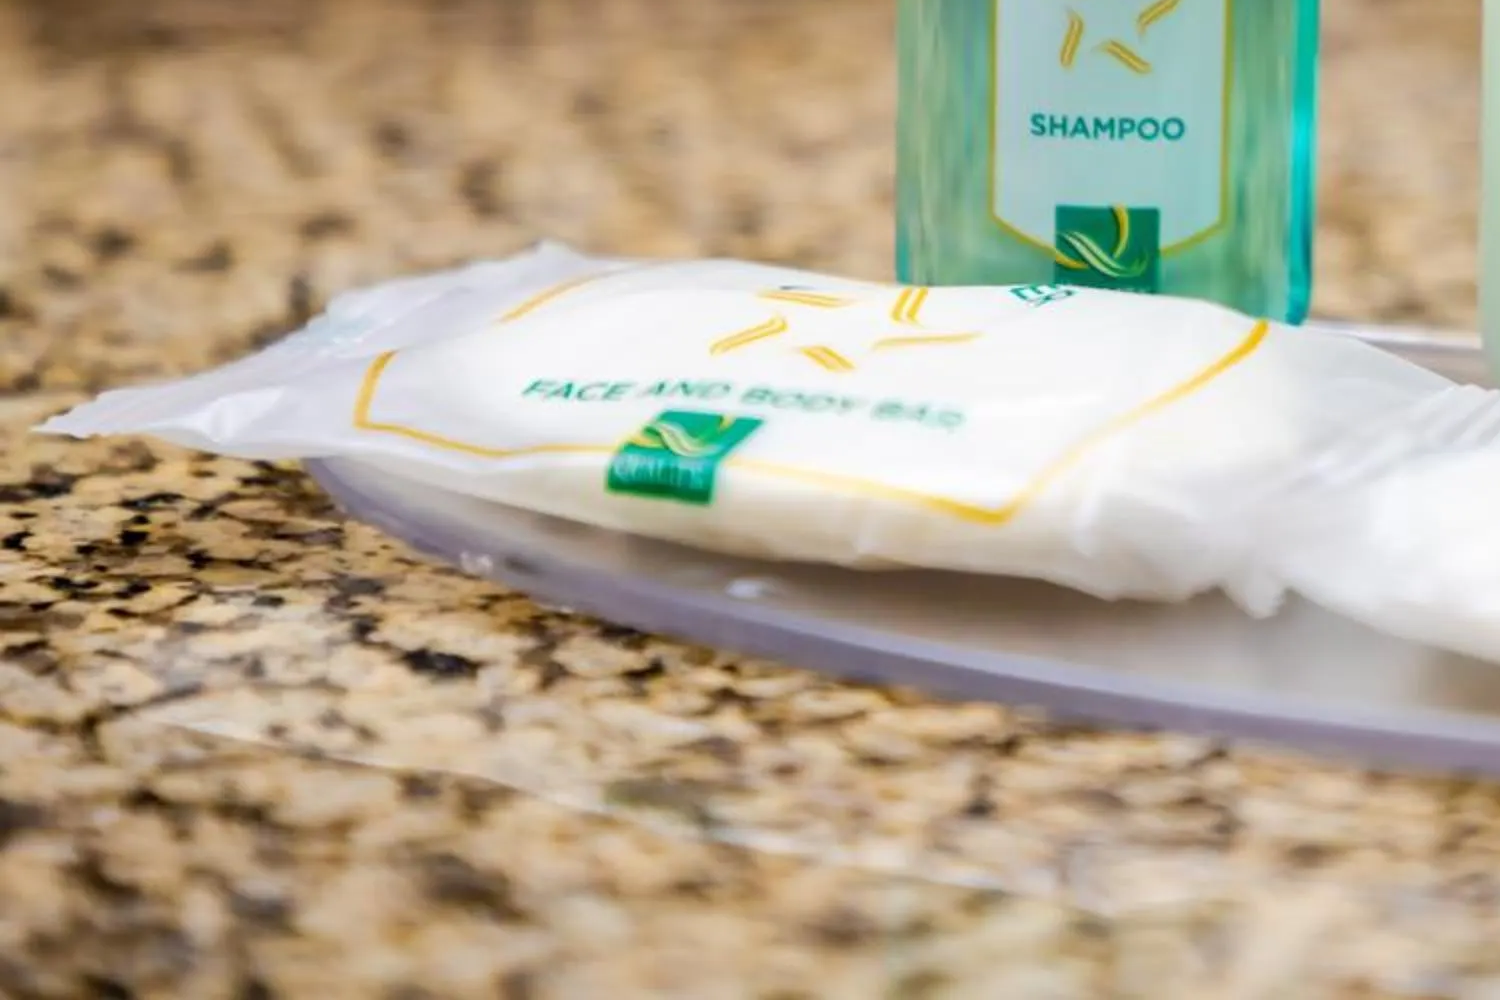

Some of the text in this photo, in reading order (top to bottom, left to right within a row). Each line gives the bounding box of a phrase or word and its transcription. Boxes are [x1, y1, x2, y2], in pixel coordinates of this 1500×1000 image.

[1030, 113, 1186, 142] SHAMPOO
[521, 378, 968, 435] FACE AND BODY BAR
